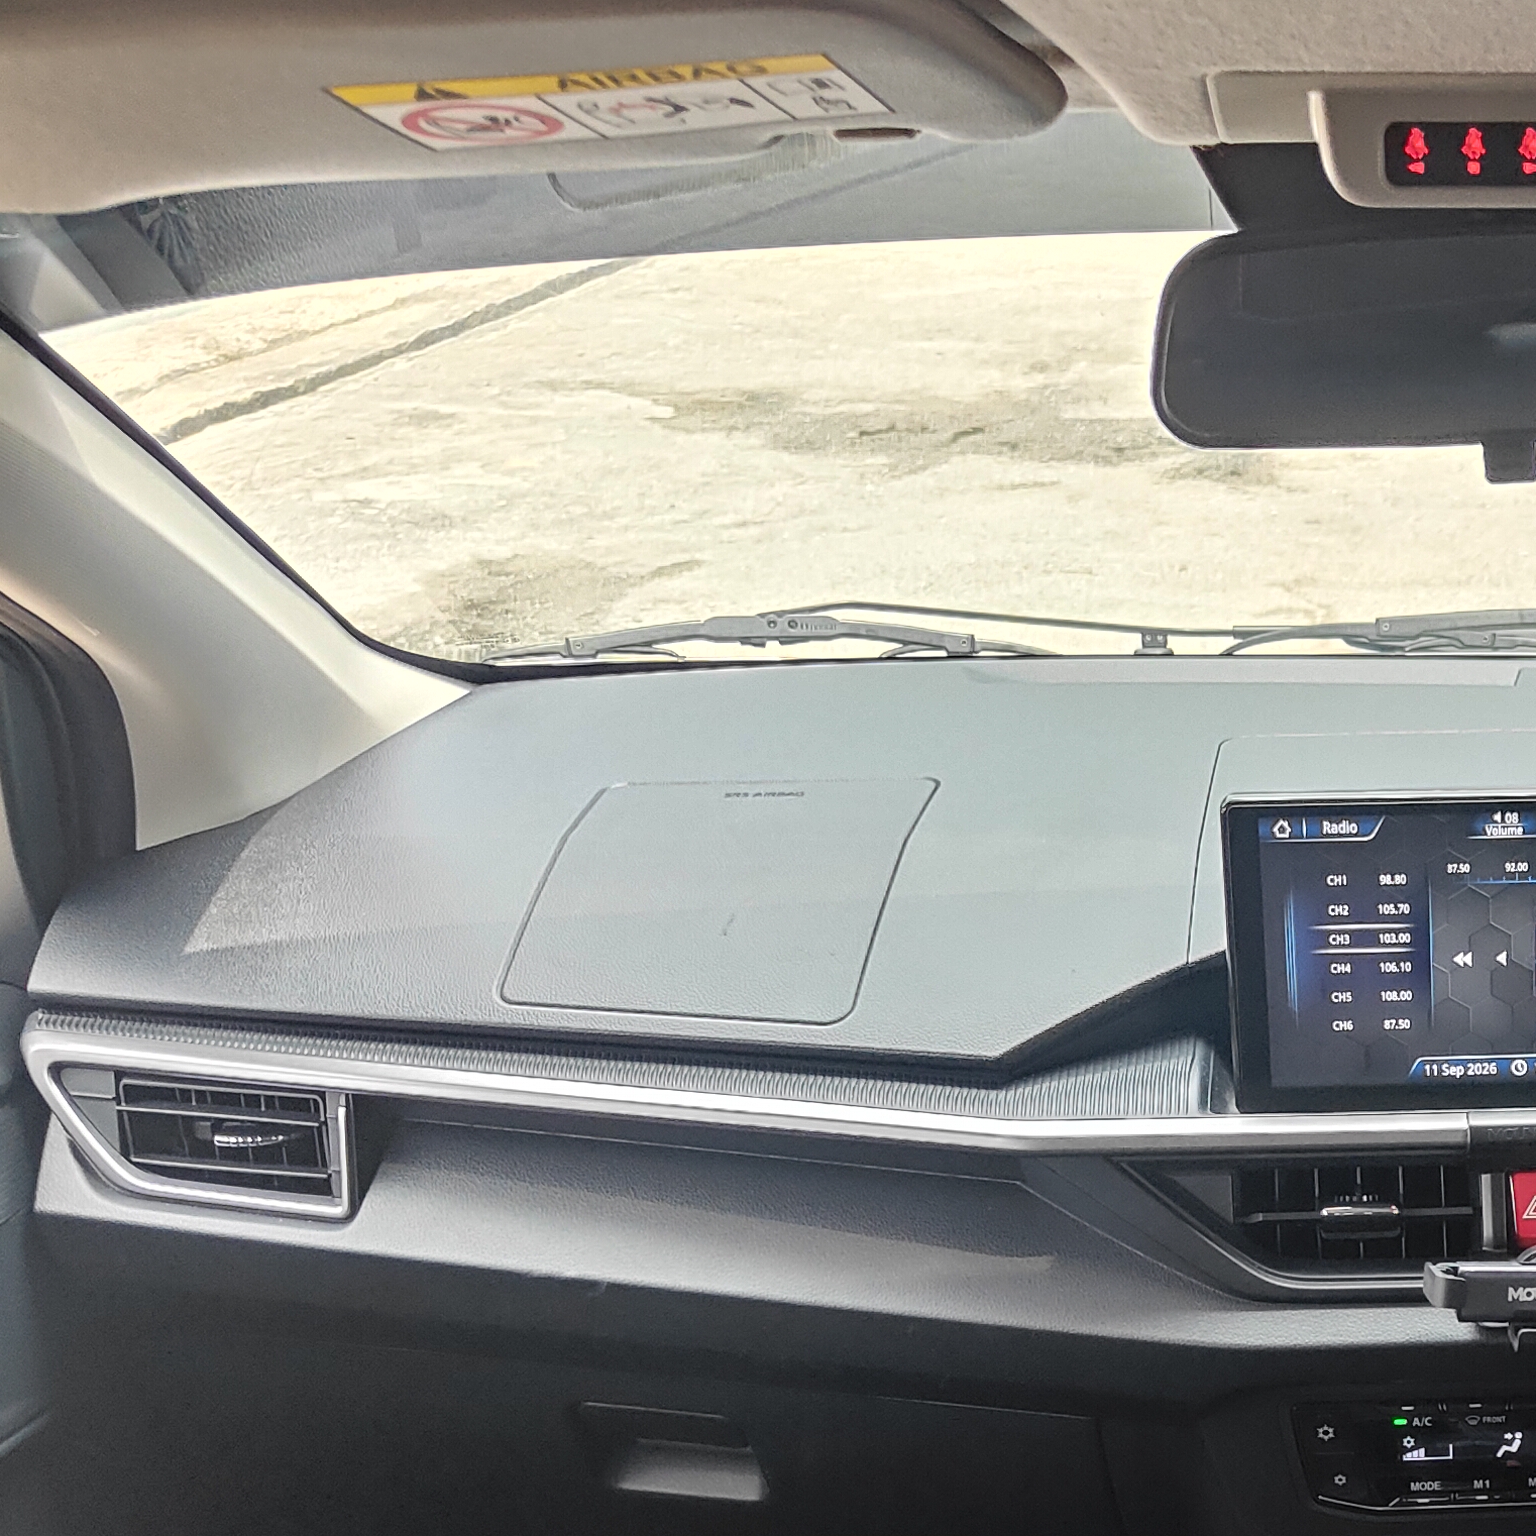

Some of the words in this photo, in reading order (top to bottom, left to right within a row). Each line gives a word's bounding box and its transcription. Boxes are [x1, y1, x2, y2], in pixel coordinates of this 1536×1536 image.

[1505, 811, 1520, 824] 08
[1322, 820, 1358, 836] Radio
[1484, 825, 1524, 837] Volume
[1504, 862, 1529, 873] 92.00
[1326, 875, 1348, 886] CH1
[1379, 874, 1407, 885] 98.80
[1328, 905, 1349, 916] CH2
[1377, 904, 1410, 915] 105.70
[1328, 934, 1350, 945] CH3
[1378, 933, 1411, 944] 103.00
[1330, 963, 1351, 974] CH4
[1379, 962, 1412, 973] 106.10
[1331, 992, 1352, 1002] CH5
[1380, 990, 1413, 1001] 108.00
[1332, 1020, 1354, 1031] CH6
[1383, 1019, 1411, 1030] 87.50
[1424, 1064, 1438, 1076] 11
[1442, 1063, 1465, 1078] Sep
[1466, 1062, 1497, 1075] 2026
[1412, 1416, 1433, 1427] A/C
[1482, 1415, 1507, 1425] FRONT
[1410, 1481, 1442, 1491] MODE
